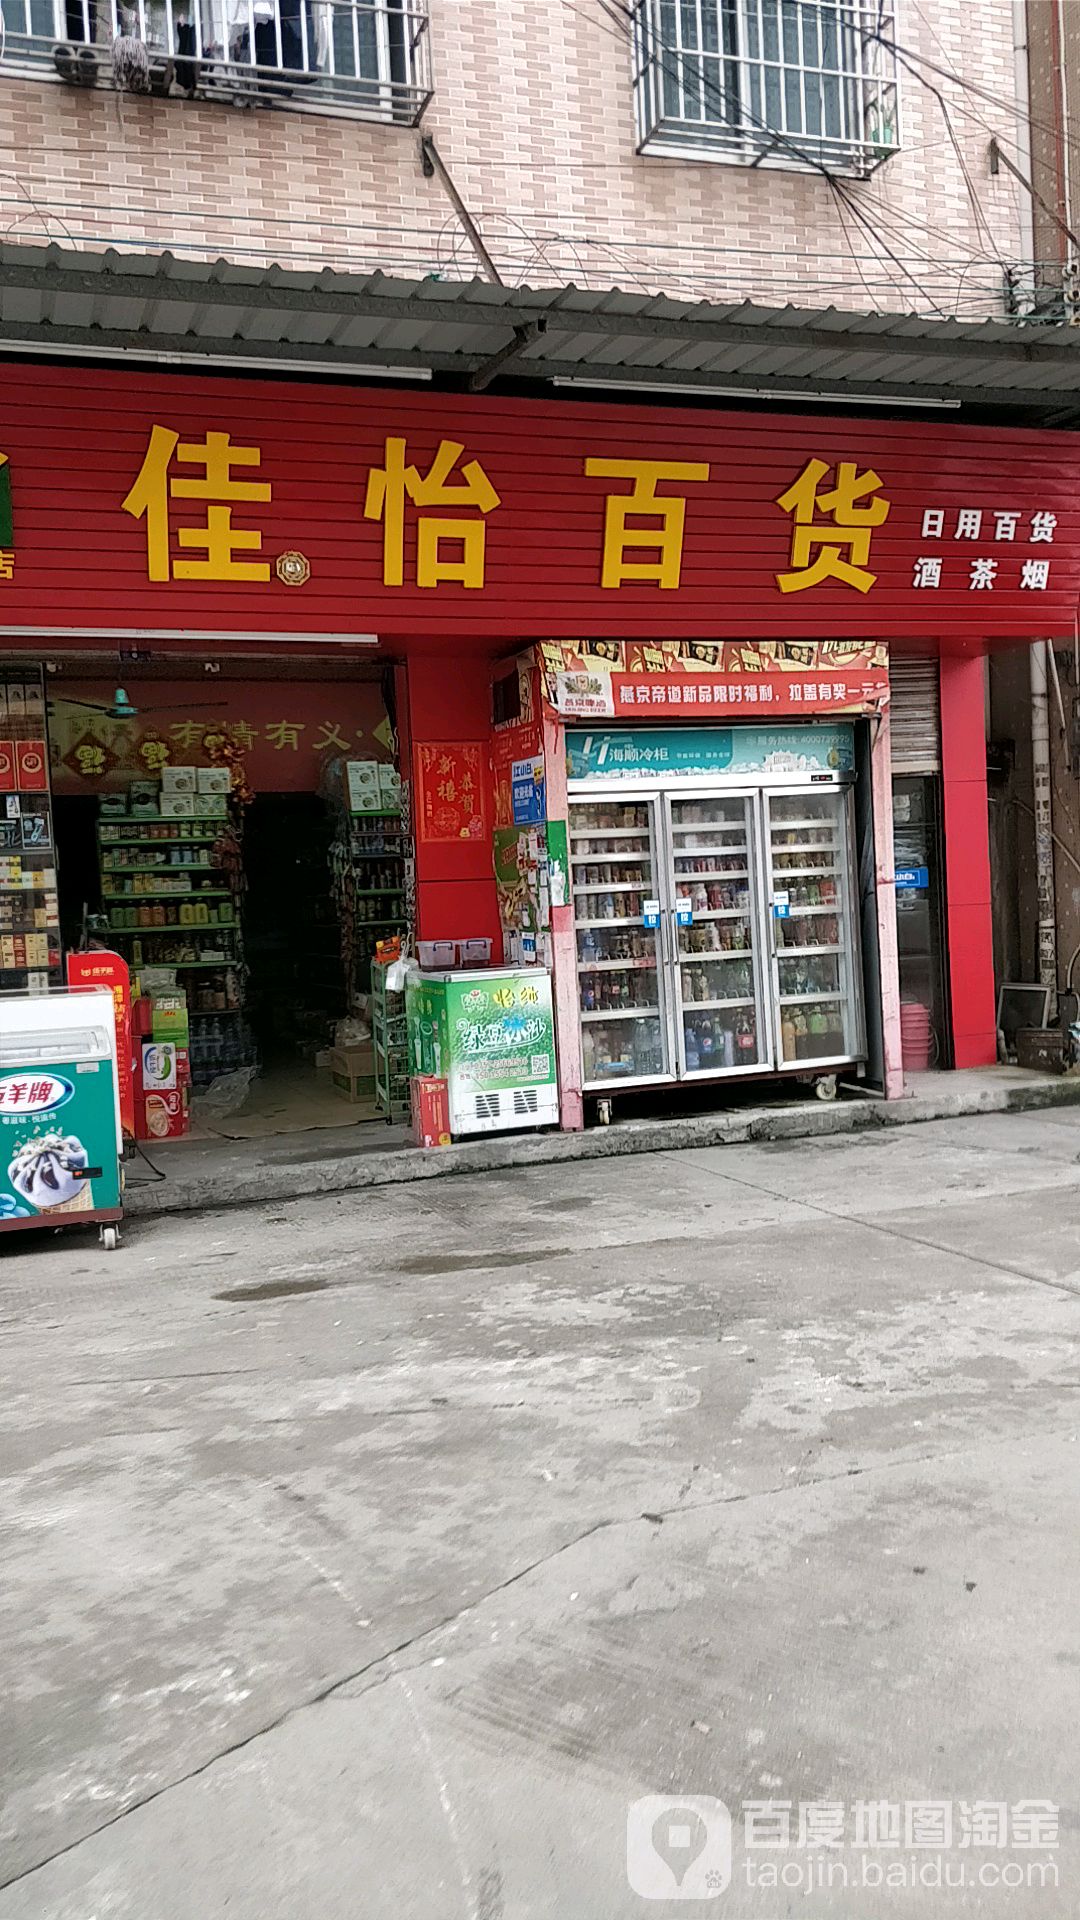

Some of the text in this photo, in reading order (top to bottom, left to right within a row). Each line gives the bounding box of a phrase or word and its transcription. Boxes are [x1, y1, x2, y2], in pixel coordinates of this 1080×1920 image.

[124, 427, 887, 592] 佳怡百货
[921, 508, 1058, 544] 日用百货
[912, 557, 1051, 591] 酒茶烟
